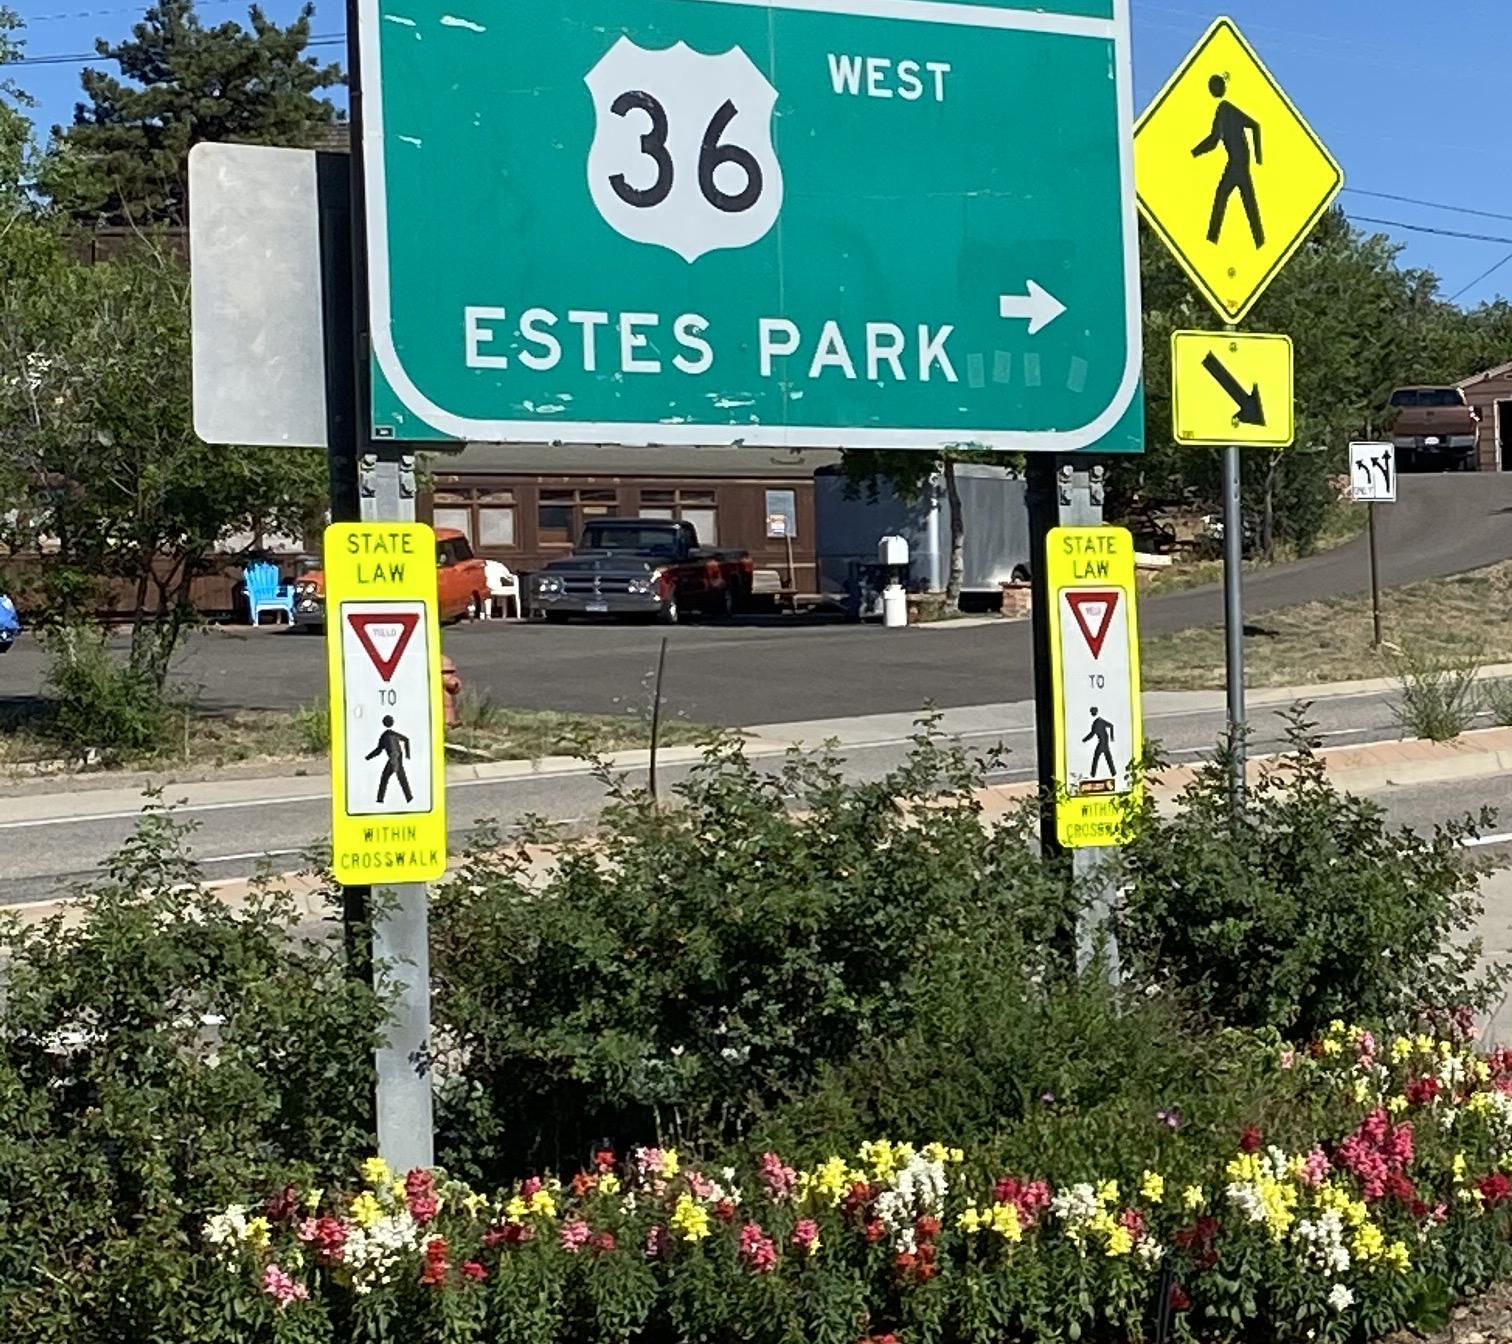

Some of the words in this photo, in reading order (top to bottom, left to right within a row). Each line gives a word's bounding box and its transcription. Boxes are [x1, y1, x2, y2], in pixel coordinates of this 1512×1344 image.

[828, 53, 952, 102] WEST
[608, 90, 763, 213] 36
[464, 305, 714, 374] ESTES
[758, 317, 959, 383] PARK
[347, 532, 414, 554] STATE
[1063, 535, 1117, 555] STATE
[357, 562, 405, 584] LAW
[1072, 559, 1109, 579] LAW
[1088, 674, 1105, 689] TO
[378, 688, 397, 706] TO
[363, 825, 416, 843] WITHIN
[341, 849, 438, 870] CROSSWALK
